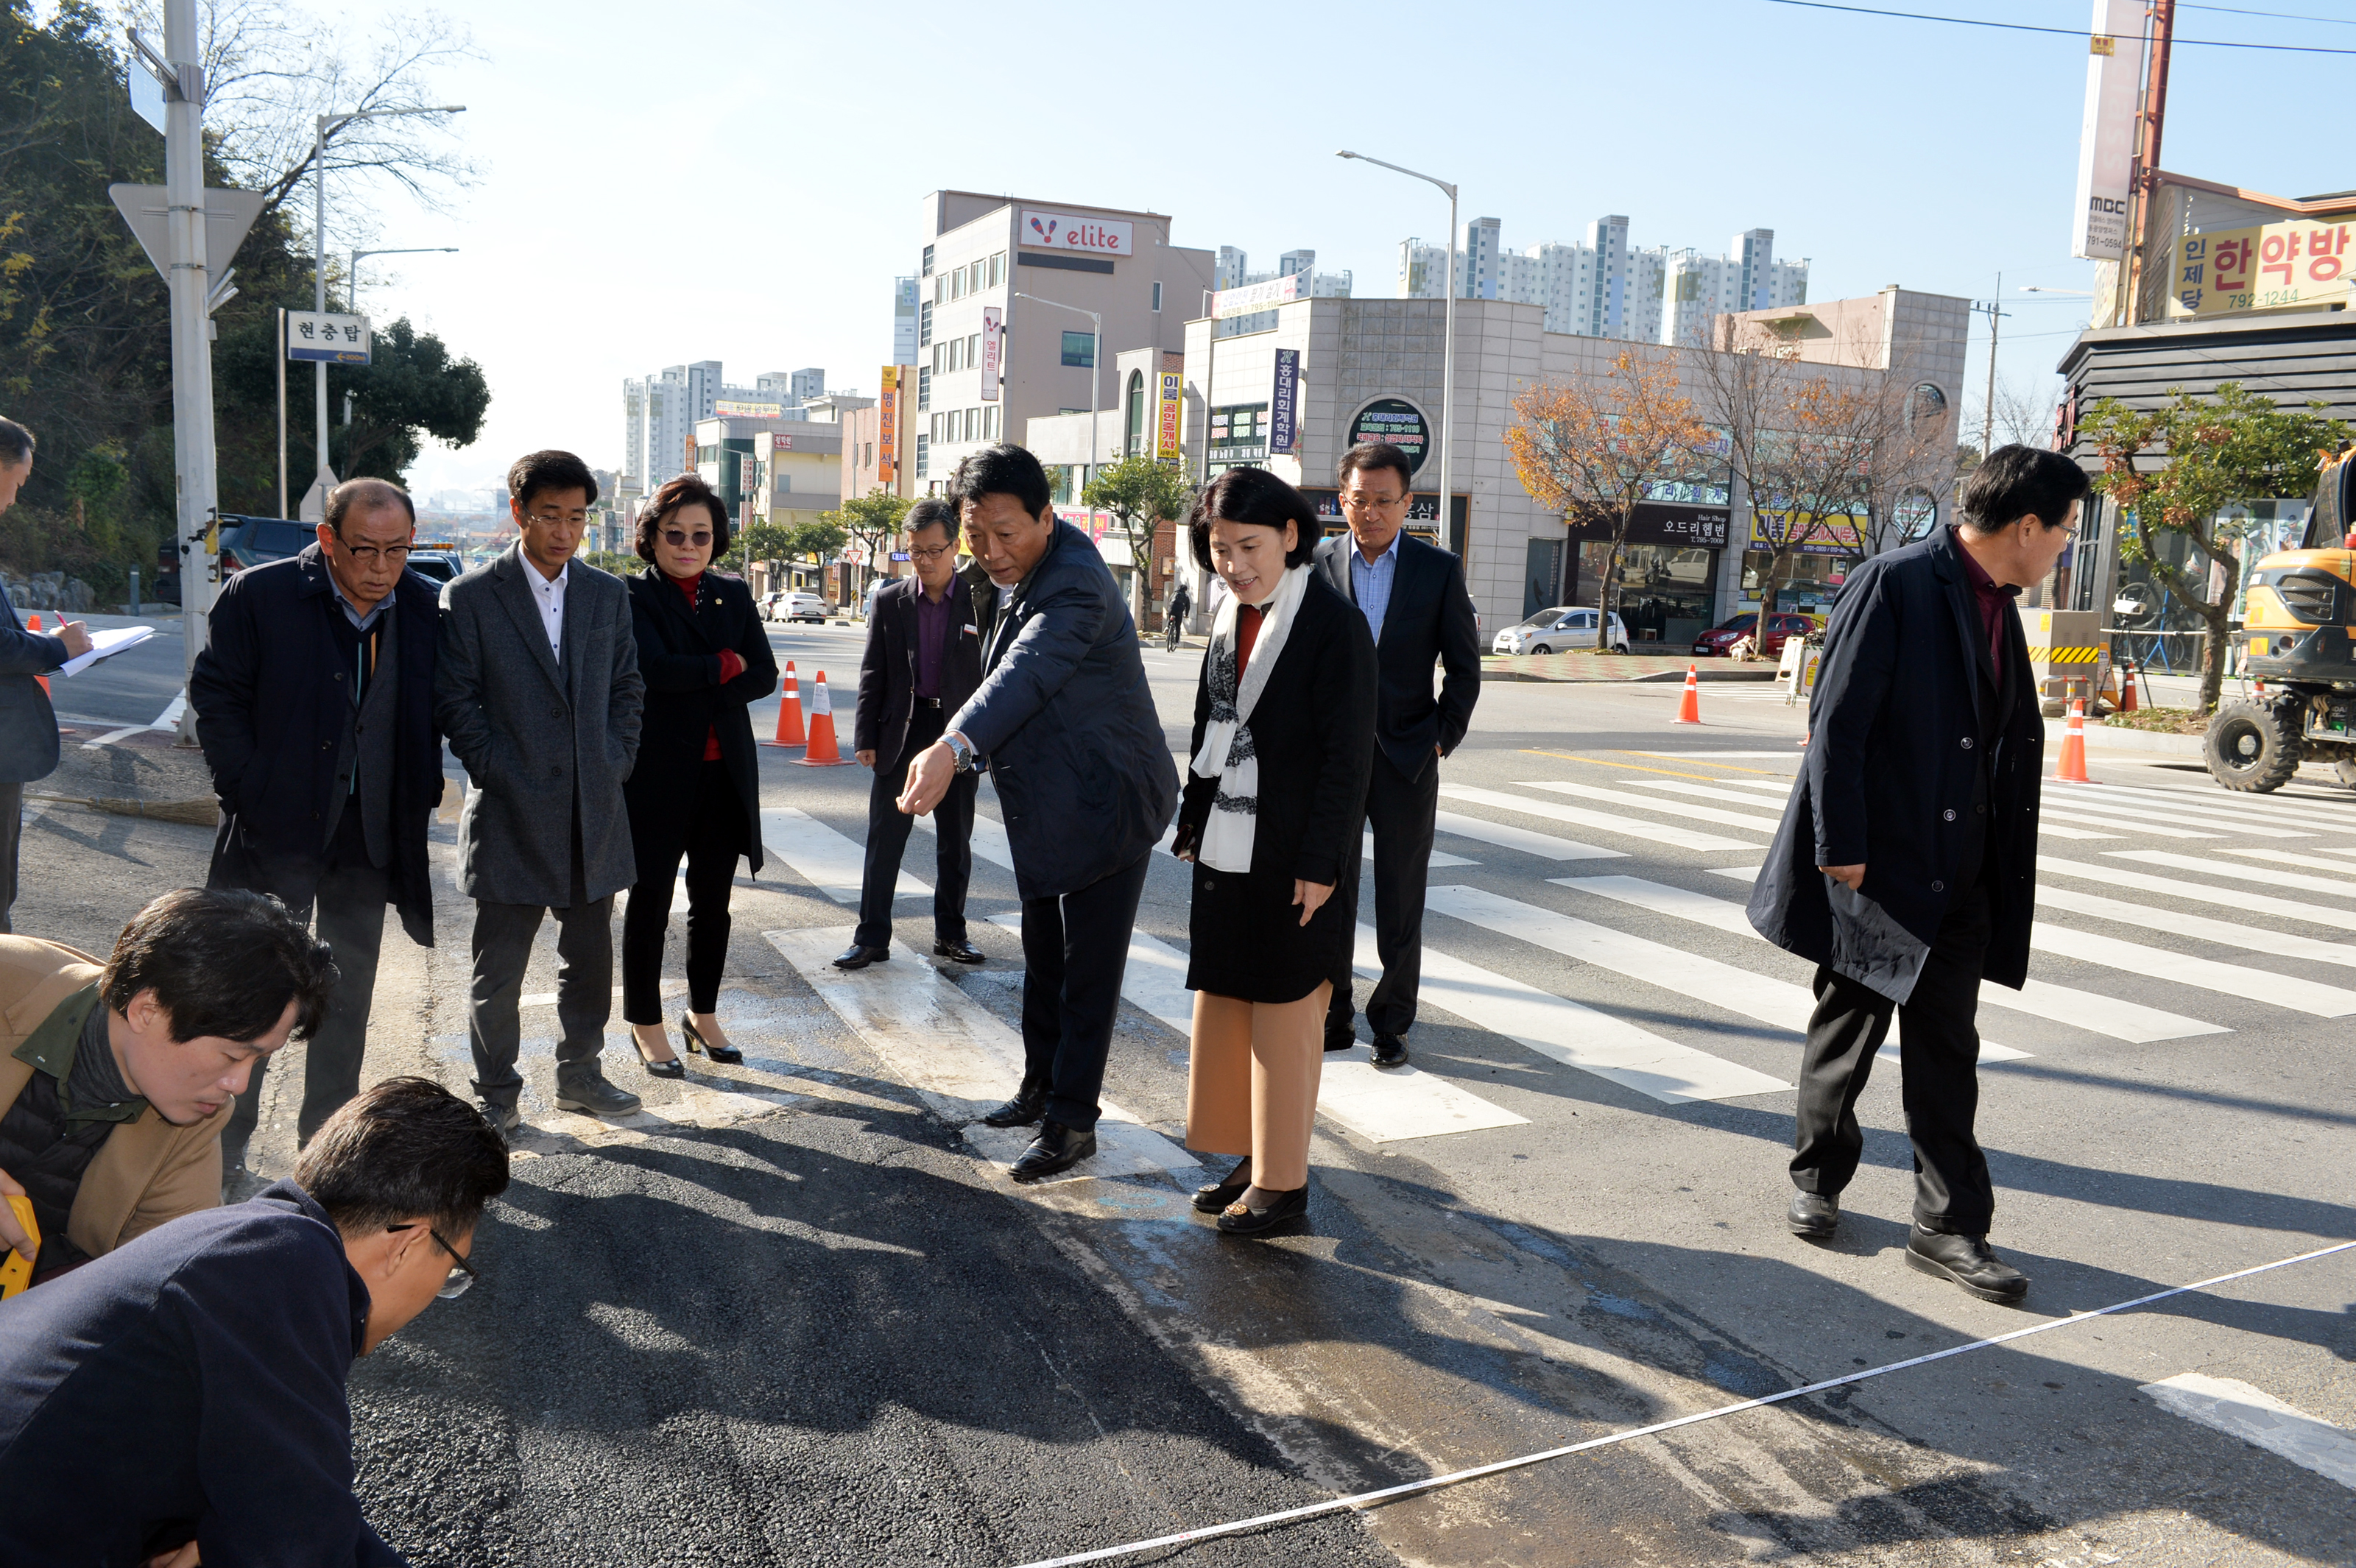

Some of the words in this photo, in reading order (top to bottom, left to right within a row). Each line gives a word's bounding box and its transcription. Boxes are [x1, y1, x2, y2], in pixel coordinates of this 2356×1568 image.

[2090, 196, 2126, 215] MBC
[1067, 225, 1119, 249] elite
[2087, 235, 2122, 249] 791-0594
[2214, 225, 2351, 292] 한약방
[2181, 238, 2207, 310] 인제당
[2229, 289, 2299, 308] 792-1244
[298, 321, 361, 342] 현충탑
[987, 340, 996, 371] 엘리트
[1275, 364, 1292, 447] 홍대리회계학원
[1162, 403, 1177, 450] 공인중개사
[1372, 413, 1419, 423] 홍대리회계학원
[1389, 424, 1420, 433] 795-1110
[881, 392, 894, 469] 명진보석
[1082, 516, 1104, 530] 공개사
[1663, 520, 1724, 537] 오드리헵번
